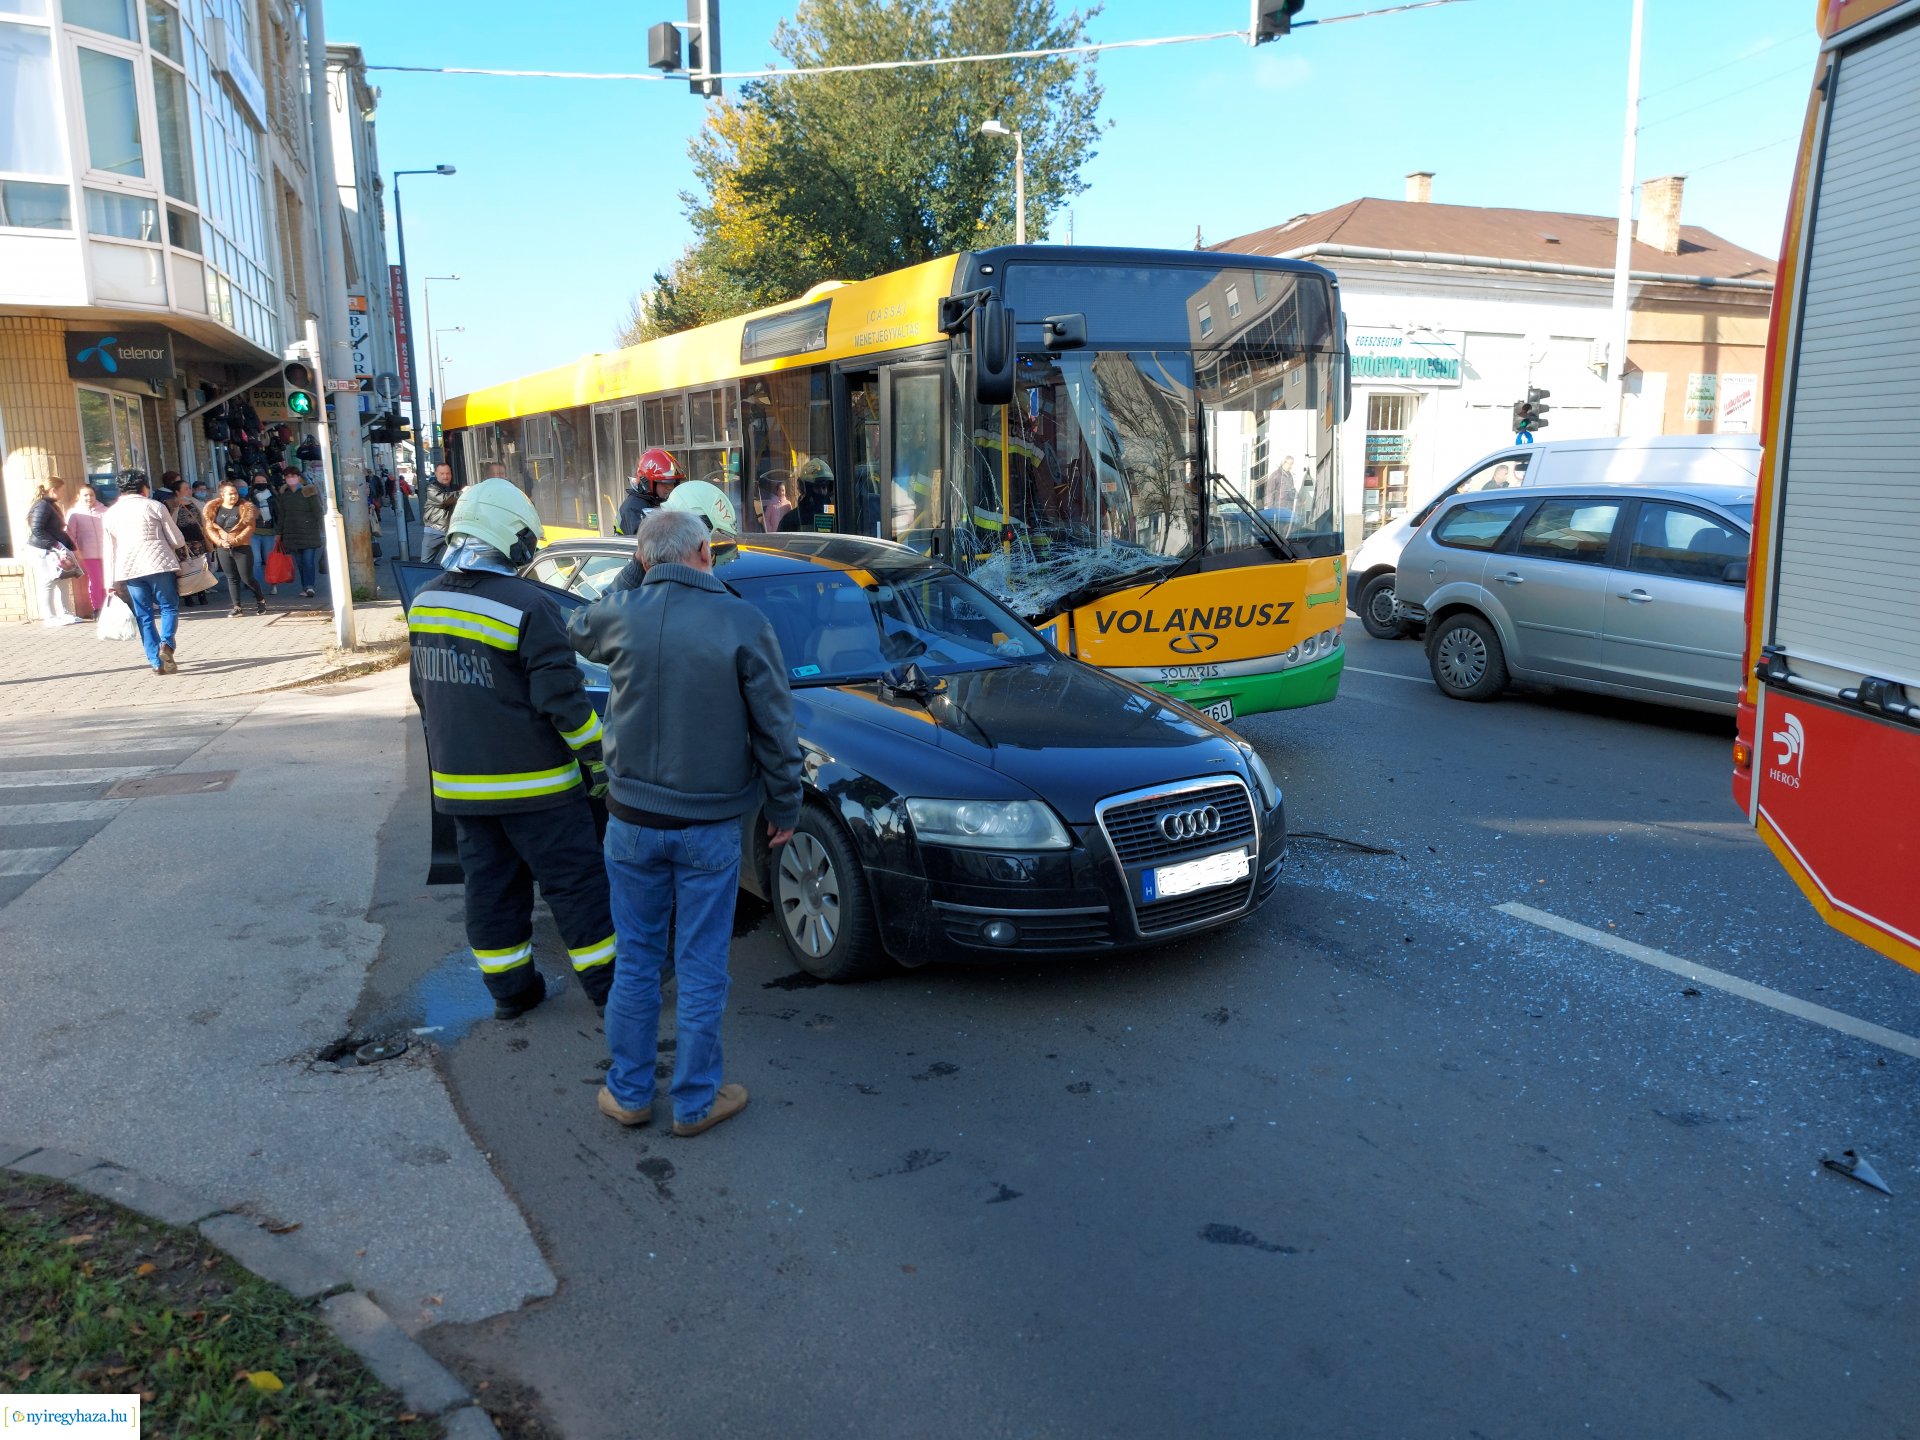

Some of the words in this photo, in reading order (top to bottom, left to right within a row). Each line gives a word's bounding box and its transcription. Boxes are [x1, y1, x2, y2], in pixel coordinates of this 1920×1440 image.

[118, 346, 165, 360] telenor
[647, 459, 663, 474] NY
[714, 498, 731, 520] NY
[1095, 601, 1296, 634] VOLÁNBUSZ
[1160, 664, 1219, 679] SOLARIS
[1769, 767, 1800, 789] HEROS
[1145, 886, 1153, 896] H
